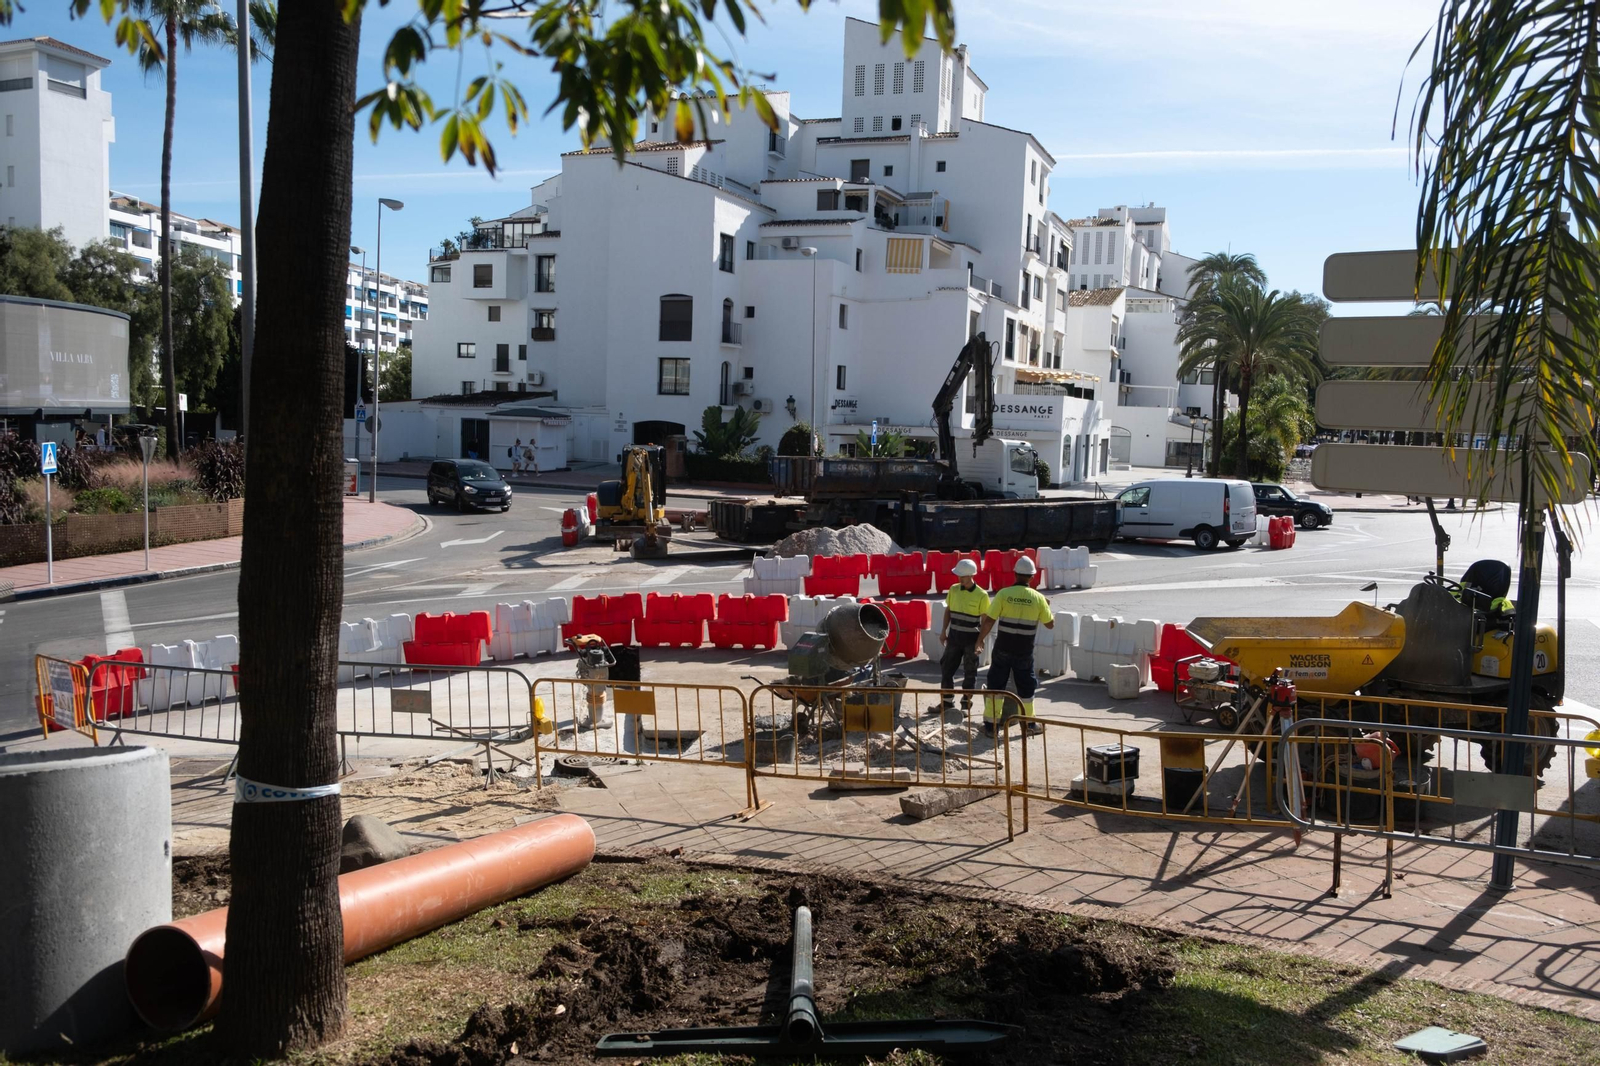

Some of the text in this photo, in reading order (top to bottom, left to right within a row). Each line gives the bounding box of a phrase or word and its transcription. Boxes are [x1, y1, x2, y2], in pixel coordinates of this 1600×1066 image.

[50, 351, 74, 363] VILLA
[834, 399, 858, 409] DESSANGE
[992, 404, 1054, 415] DESSANGE
[1289, 653, 1331, 662] WACKER
[1536, 653, 1546, 669] 20
